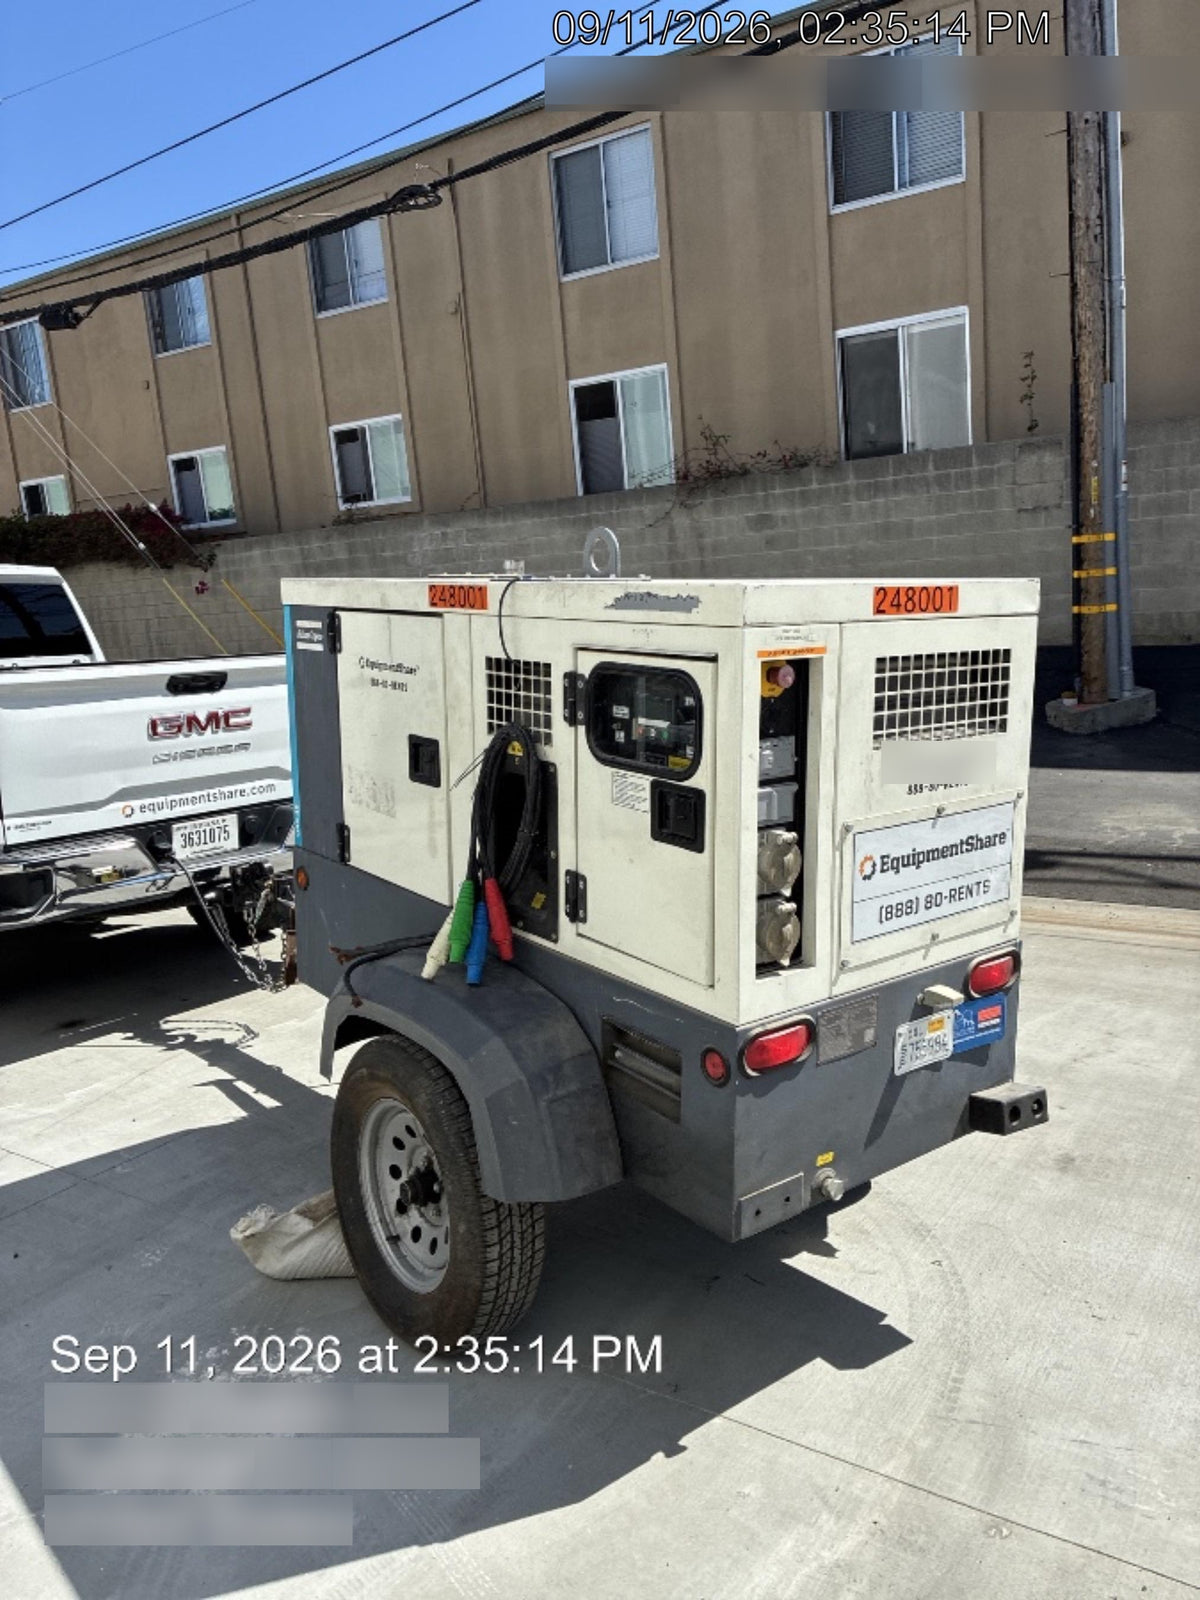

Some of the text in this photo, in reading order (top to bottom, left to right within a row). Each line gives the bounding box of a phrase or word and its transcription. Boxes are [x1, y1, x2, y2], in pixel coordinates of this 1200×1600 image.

[429, 584, 486, 609] 248001
[875, 585, 957, 615] 248001
[148, 707, 253, 741] GMC
[139, 782, 276, 813] equipmentshare.com
[180, 825, 230, 849] 3631075
[879, 831, 1006, 874] EquipmentShare
[878, 879, 991, 924] (888) 80-RENTS
